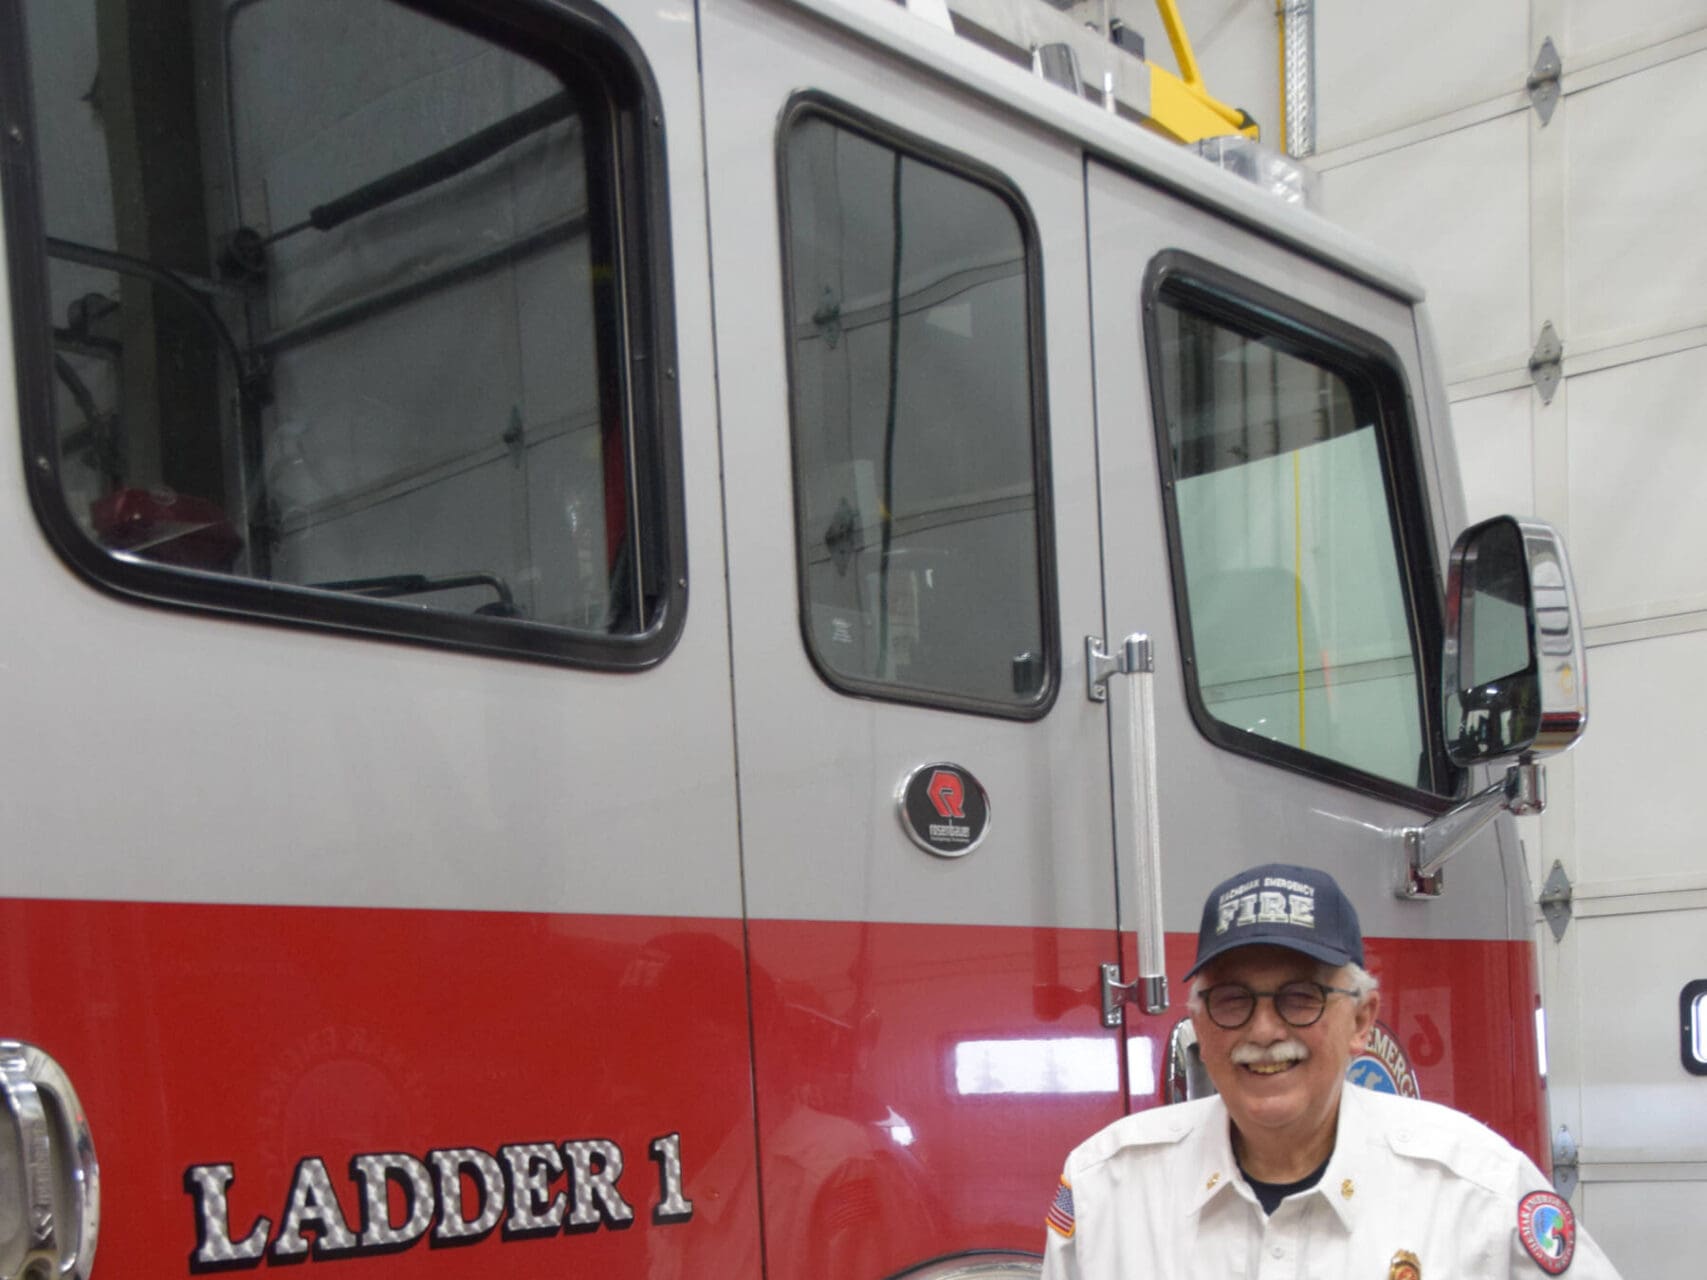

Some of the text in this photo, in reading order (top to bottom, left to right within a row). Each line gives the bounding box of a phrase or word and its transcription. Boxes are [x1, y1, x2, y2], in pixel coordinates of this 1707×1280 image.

[1264, 877, 1315, 897] EMERGENCY
[1216, 891, 1315, 936] FIRE
[184, 1139, 634, 1274] LADDER
[648, 1132, 693, 1225] 1
